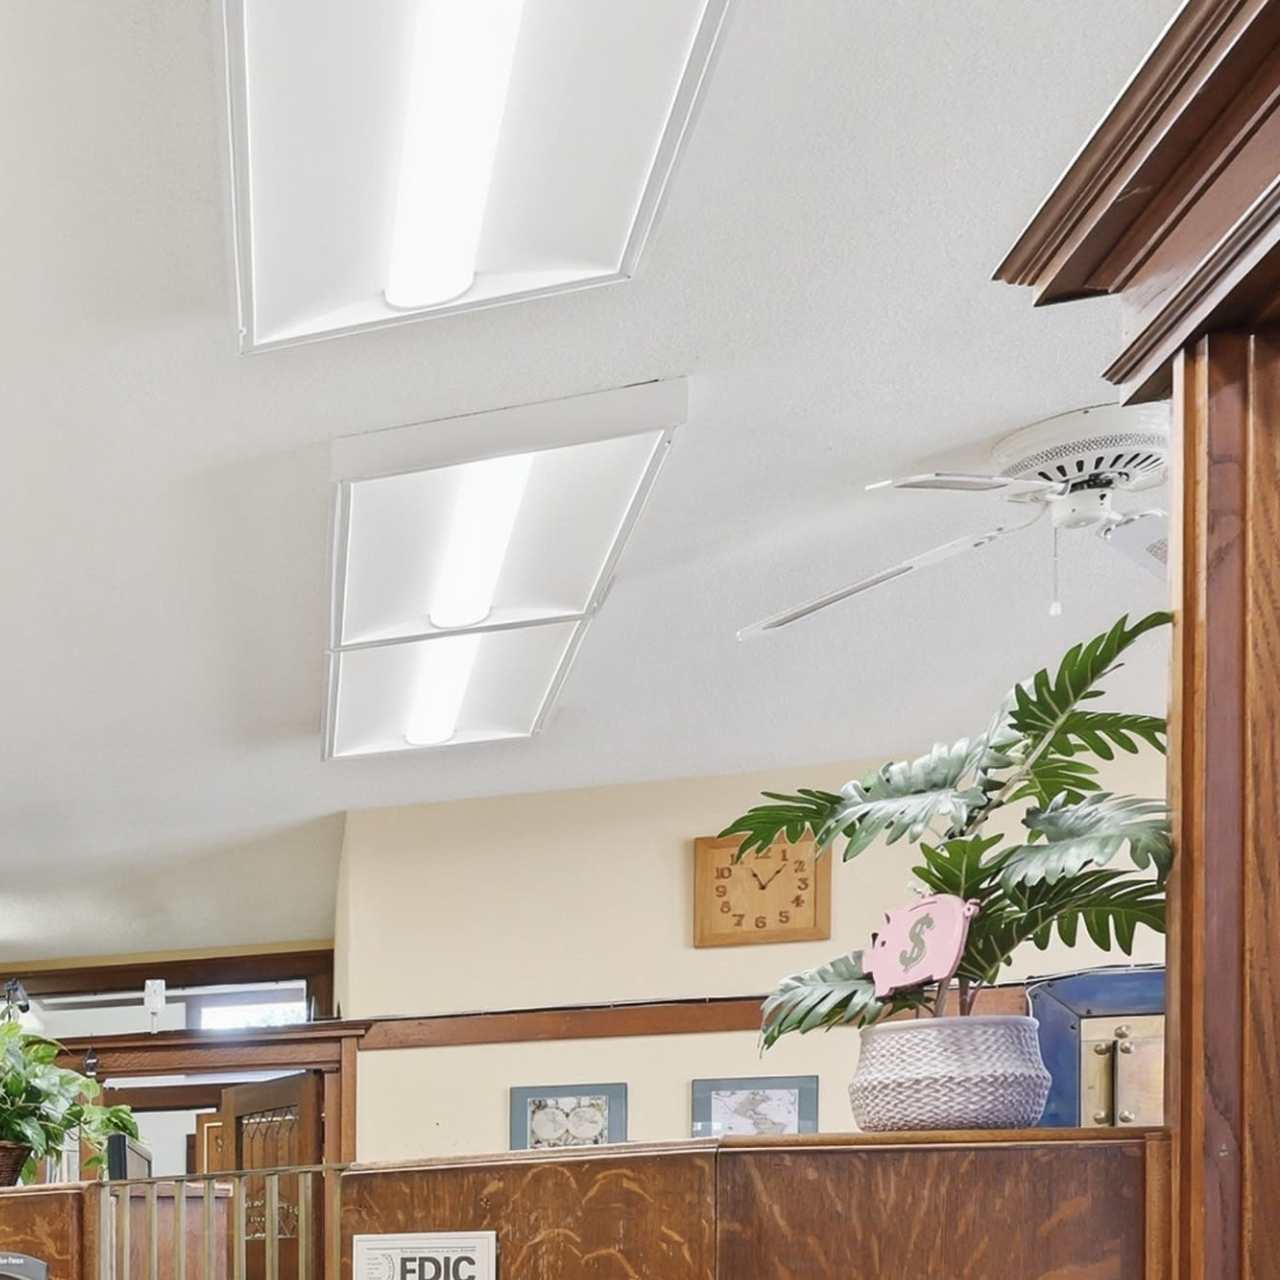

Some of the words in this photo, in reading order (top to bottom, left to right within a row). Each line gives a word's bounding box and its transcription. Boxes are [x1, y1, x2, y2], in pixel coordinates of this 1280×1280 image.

[781, 849, 788, 861] 1
[715, 867, 732, 879] 10
[794, 860, 806, 873] 2
[797, 878, 809, 891] 3
[715, 885, 727, 898] 9
[720, 901, 731, 914] 8
[790, 895, 805, 907] 4
[731, 914, 745, 927] 7
[755, 916, 767, 929] 6
[778, 910, 790, 924] 5
